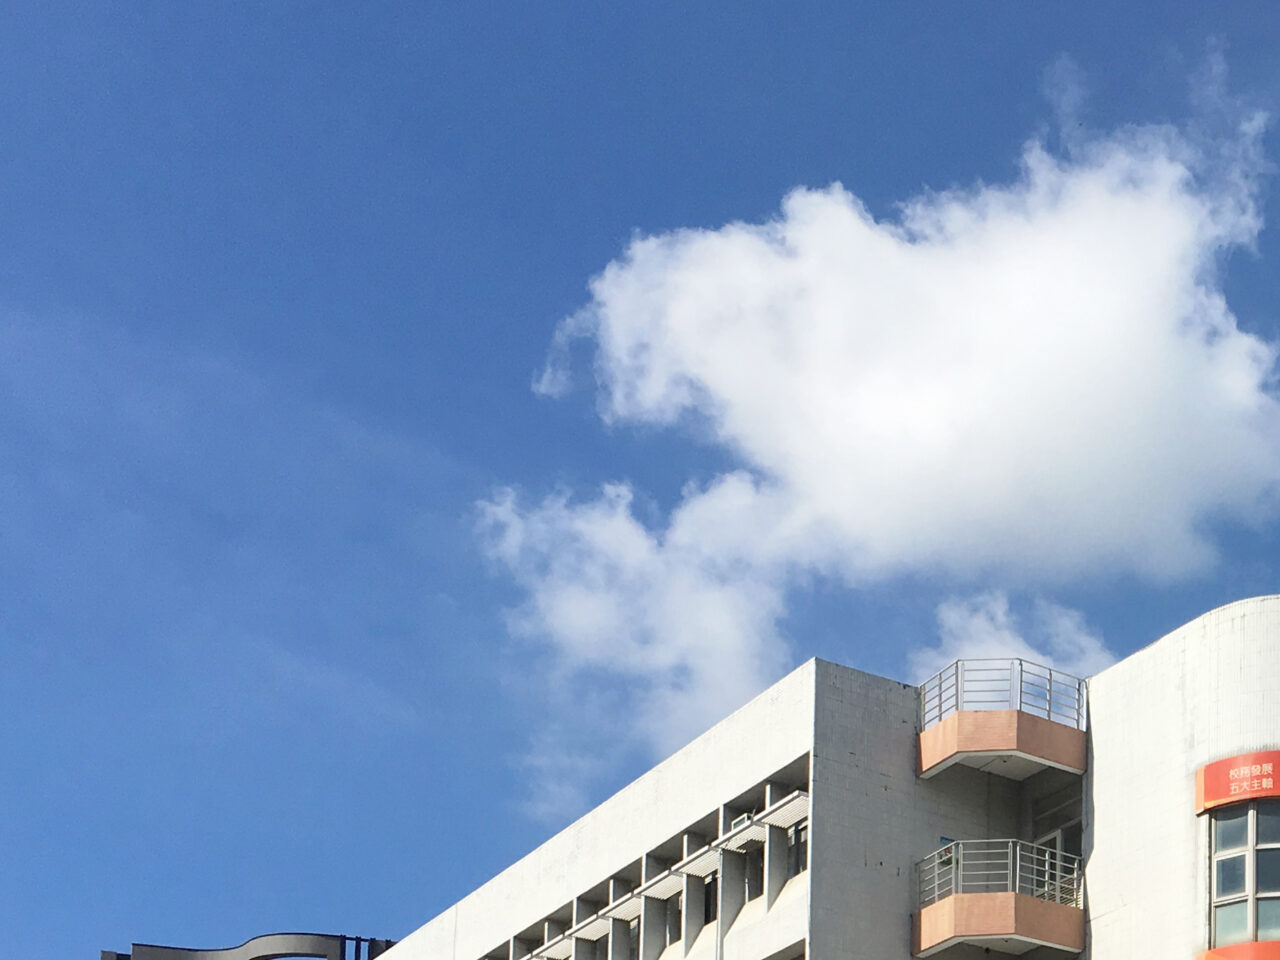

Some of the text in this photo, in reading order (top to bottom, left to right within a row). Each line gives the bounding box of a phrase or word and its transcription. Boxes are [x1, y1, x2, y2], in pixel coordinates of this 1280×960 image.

[1229, 762, 1273, 780] 校務發展
[1229, 777, 1273, 795] 五大主軸
